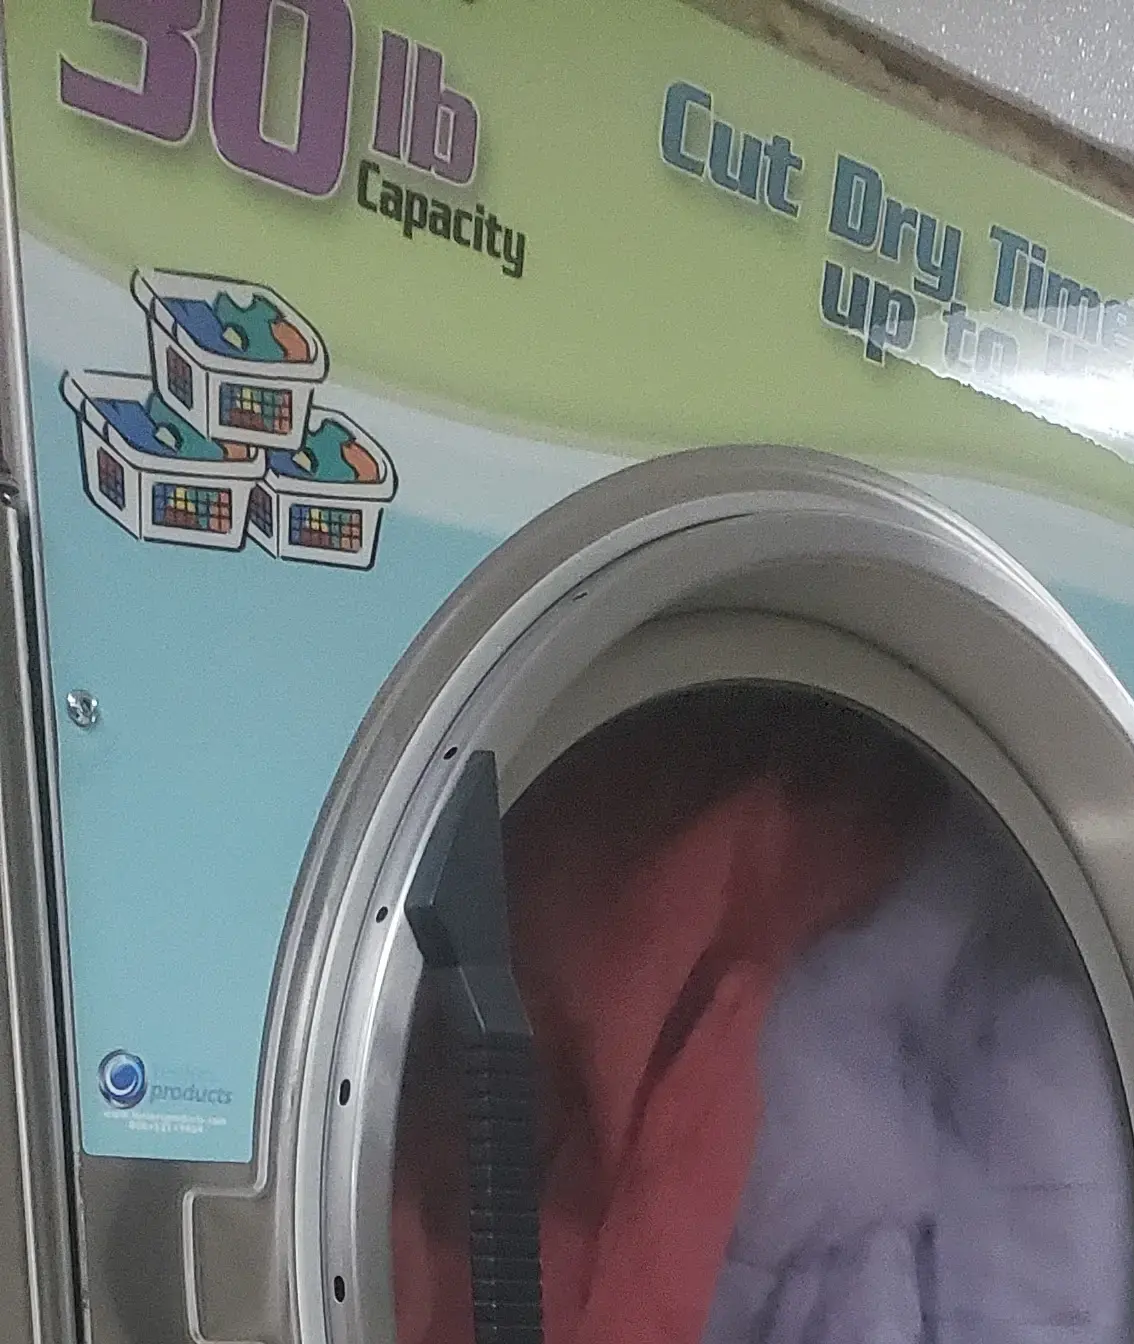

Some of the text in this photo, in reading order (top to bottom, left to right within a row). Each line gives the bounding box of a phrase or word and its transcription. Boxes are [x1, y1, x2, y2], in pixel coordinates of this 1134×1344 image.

[59, 0, 479, 197] 30 lb
[356, 160, 526, 278] Capacity
[660, 79, 804, 218] Cut
[828, 152, 962, 302] Dry
[820, 259, 917, 367] up
[941, 301, 1019, 373] to
